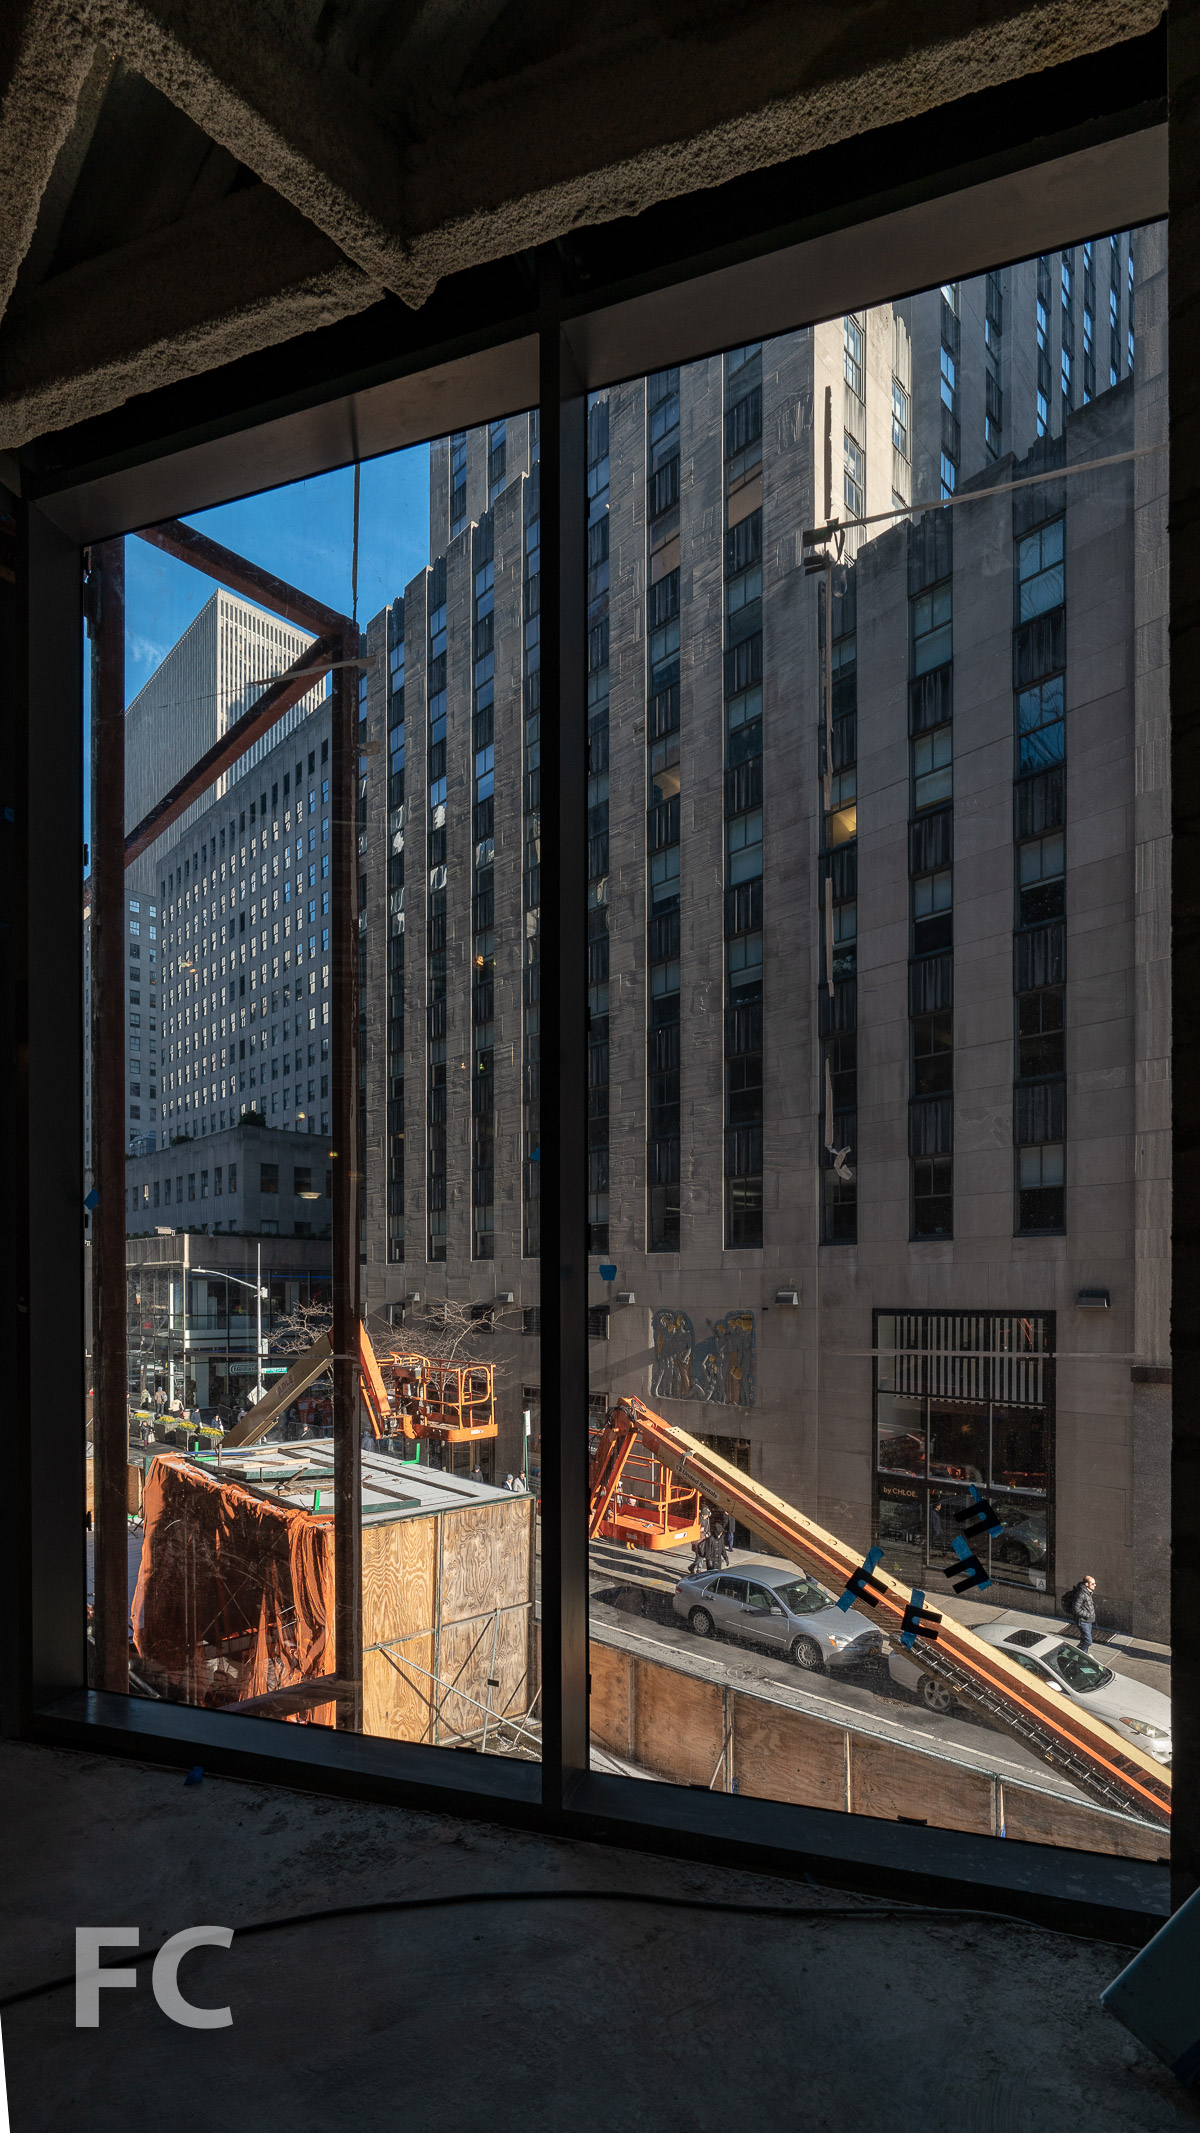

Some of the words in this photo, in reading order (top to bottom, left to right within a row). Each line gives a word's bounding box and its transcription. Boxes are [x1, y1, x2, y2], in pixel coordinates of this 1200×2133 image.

[682, 1469, 700, 1485] United
[699, 1481, 718, 1499] Rentals
[883, 1486, 891, 1495] by
